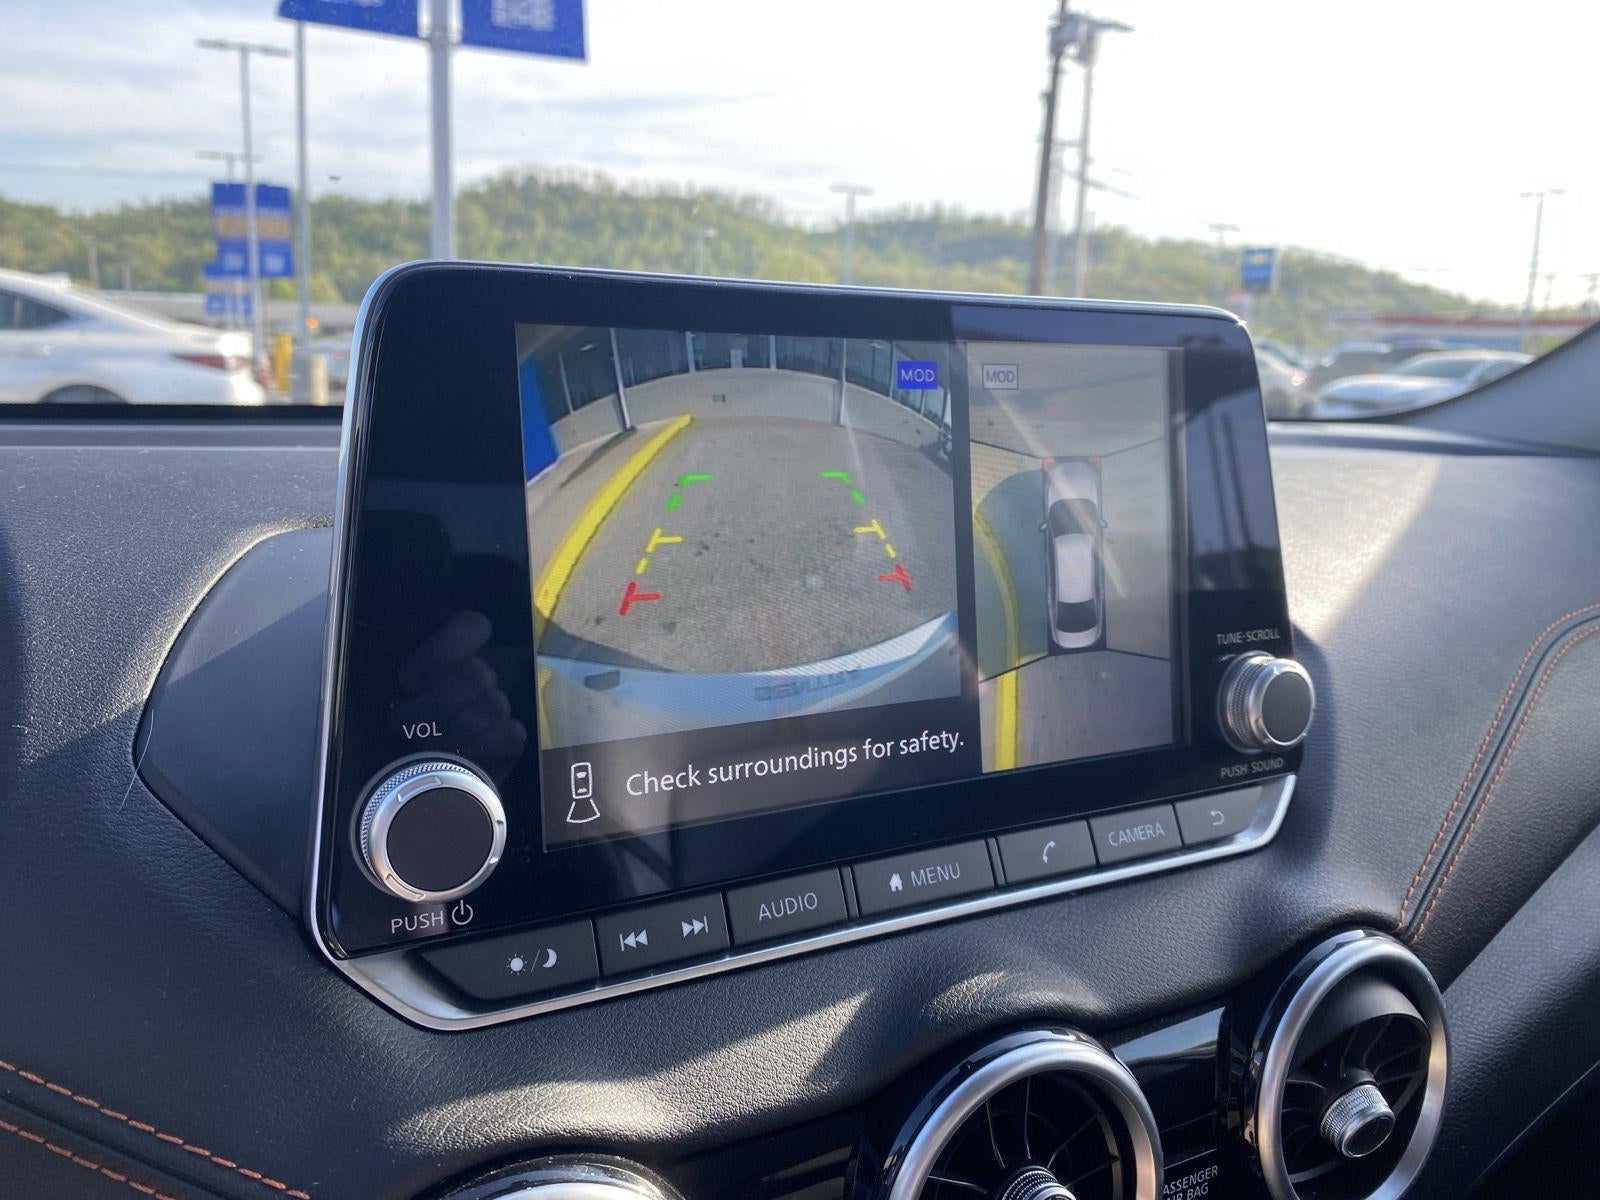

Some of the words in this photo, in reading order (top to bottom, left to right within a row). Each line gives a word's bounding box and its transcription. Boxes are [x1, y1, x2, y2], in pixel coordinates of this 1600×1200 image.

[901, 368, 935, 382] MOD
[985, 370, 1015, 384] MOD
[402, 721, 442, 739] VOL
[626, 764, 701, 797] Check
[708, 744, 857, 785] surroundings
[863, 738, 894, 760] for
[899, 730, 964, 755] safety.
[1220, 765, 1248, 778] PUSH
[1251, 757, 1284, 775] SOUND
[1108, 822, 1166, 847] CAMERA
[910, 862, 962, 888] MENU
[758, 892, 818, 921] AUDIO
[391, 910, 444, 934] PUSH
[1163, 1165, 1219, 1195] ASSENGER
[1186, 1182, 1209, 1200] BAG
